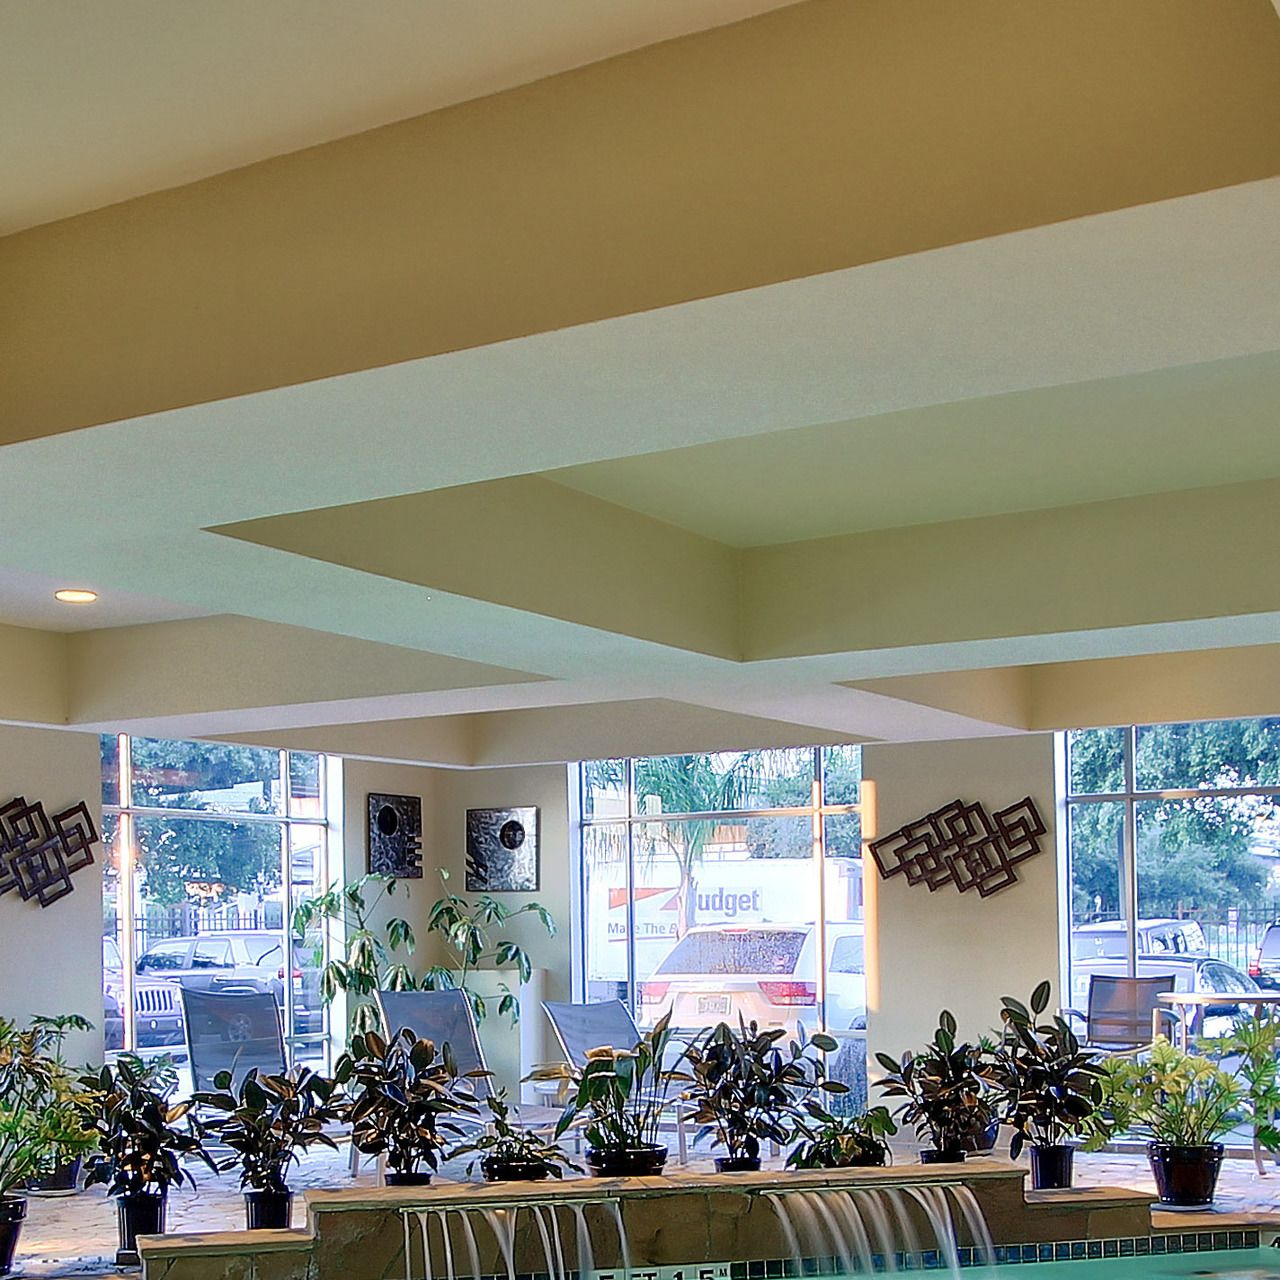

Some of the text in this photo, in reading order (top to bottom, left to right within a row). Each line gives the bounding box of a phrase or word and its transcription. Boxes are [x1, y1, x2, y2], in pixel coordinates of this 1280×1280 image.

[698, 887, 760, 918] udget
[607, 922, 640, 935] Mae
[644, 921, 666, 935] The
